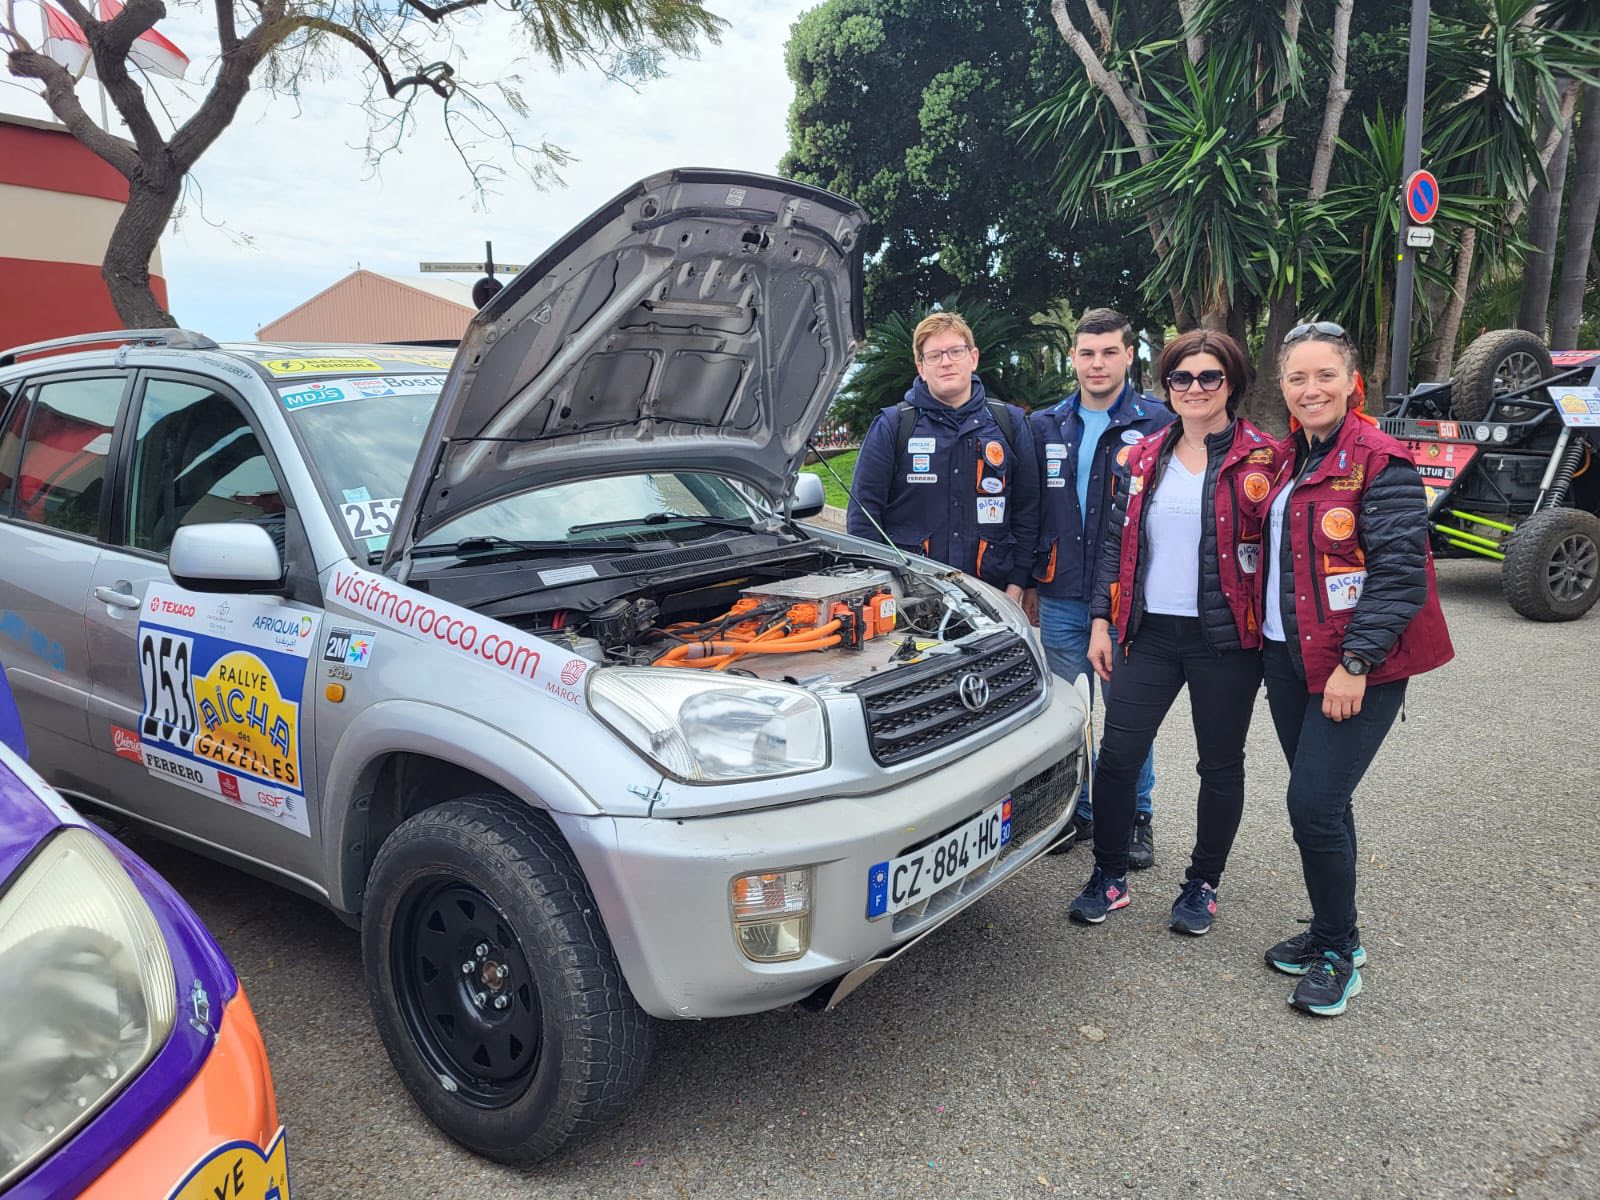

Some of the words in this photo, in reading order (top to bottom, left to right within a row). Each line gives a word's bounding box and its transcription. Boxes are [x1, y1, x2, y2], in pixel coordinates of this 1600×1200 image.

[287, 389, 339, 406] MDJS
[161, 600, 196, 618] TEXACO
[252, 615, 300, 637] AFRIQUIA
[335, 570, 541, 679] visitmorocco.com
[325, 637, 350, 659] 2M
[218, 664, 267, 692] RALLYE
[142, 635, 197, 748] 253
[545, 680, 583, 706] MAROC
[237, 731, 251, 742] des
[146, 753, 204, 784] FERRERO
[198, 735, 295, 784] GAZELLES
[257, 791, 284, 808] GSF
[1001, 823, 1011, 842] 30
[875, 895, 882, 907] F
